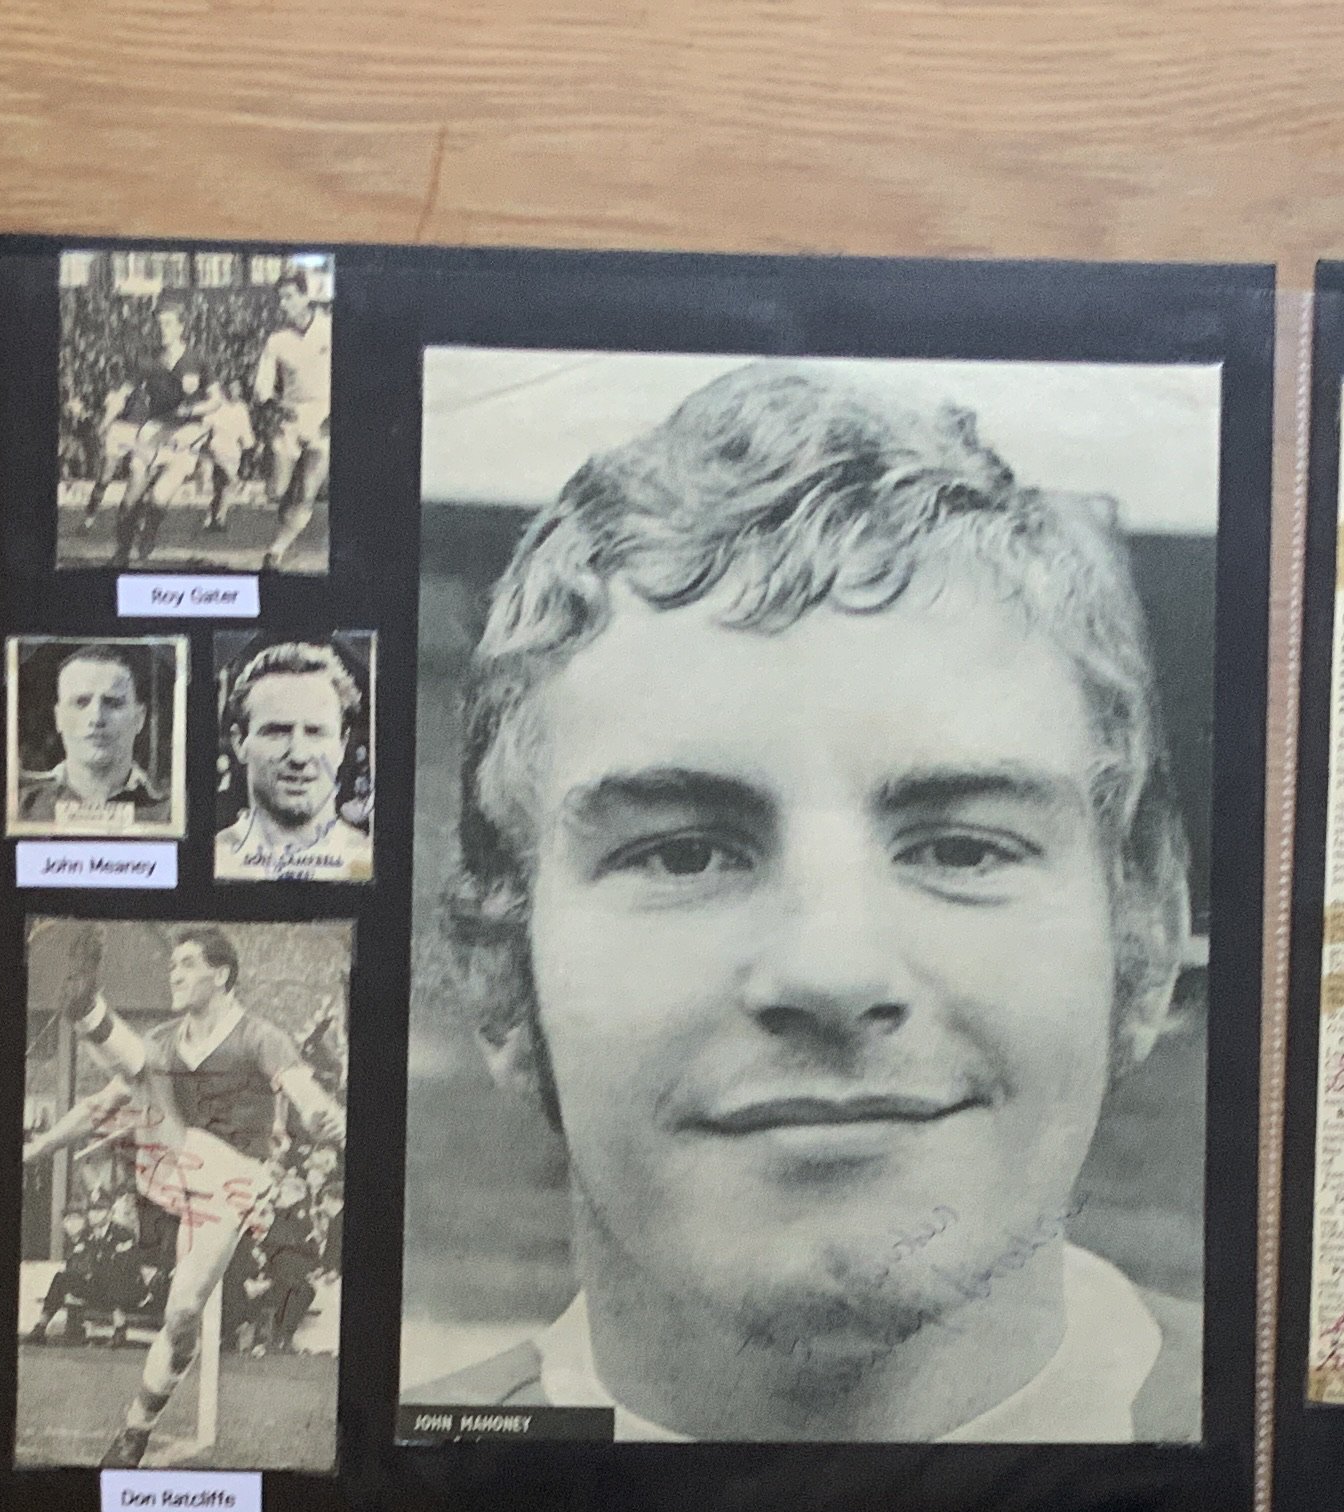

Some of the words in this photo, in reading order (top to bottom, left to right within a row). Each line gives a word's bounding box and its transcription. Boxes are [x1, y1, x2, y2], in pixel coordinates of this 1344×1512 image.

[151, 586, 185, 608] Roy
[41, 856, 84, 874] John
[414, 1414, 453, 1431] JOHN
[460, 1414, 533, 1433] MAHONEY
[121, 1488, 157, 1507] Don
